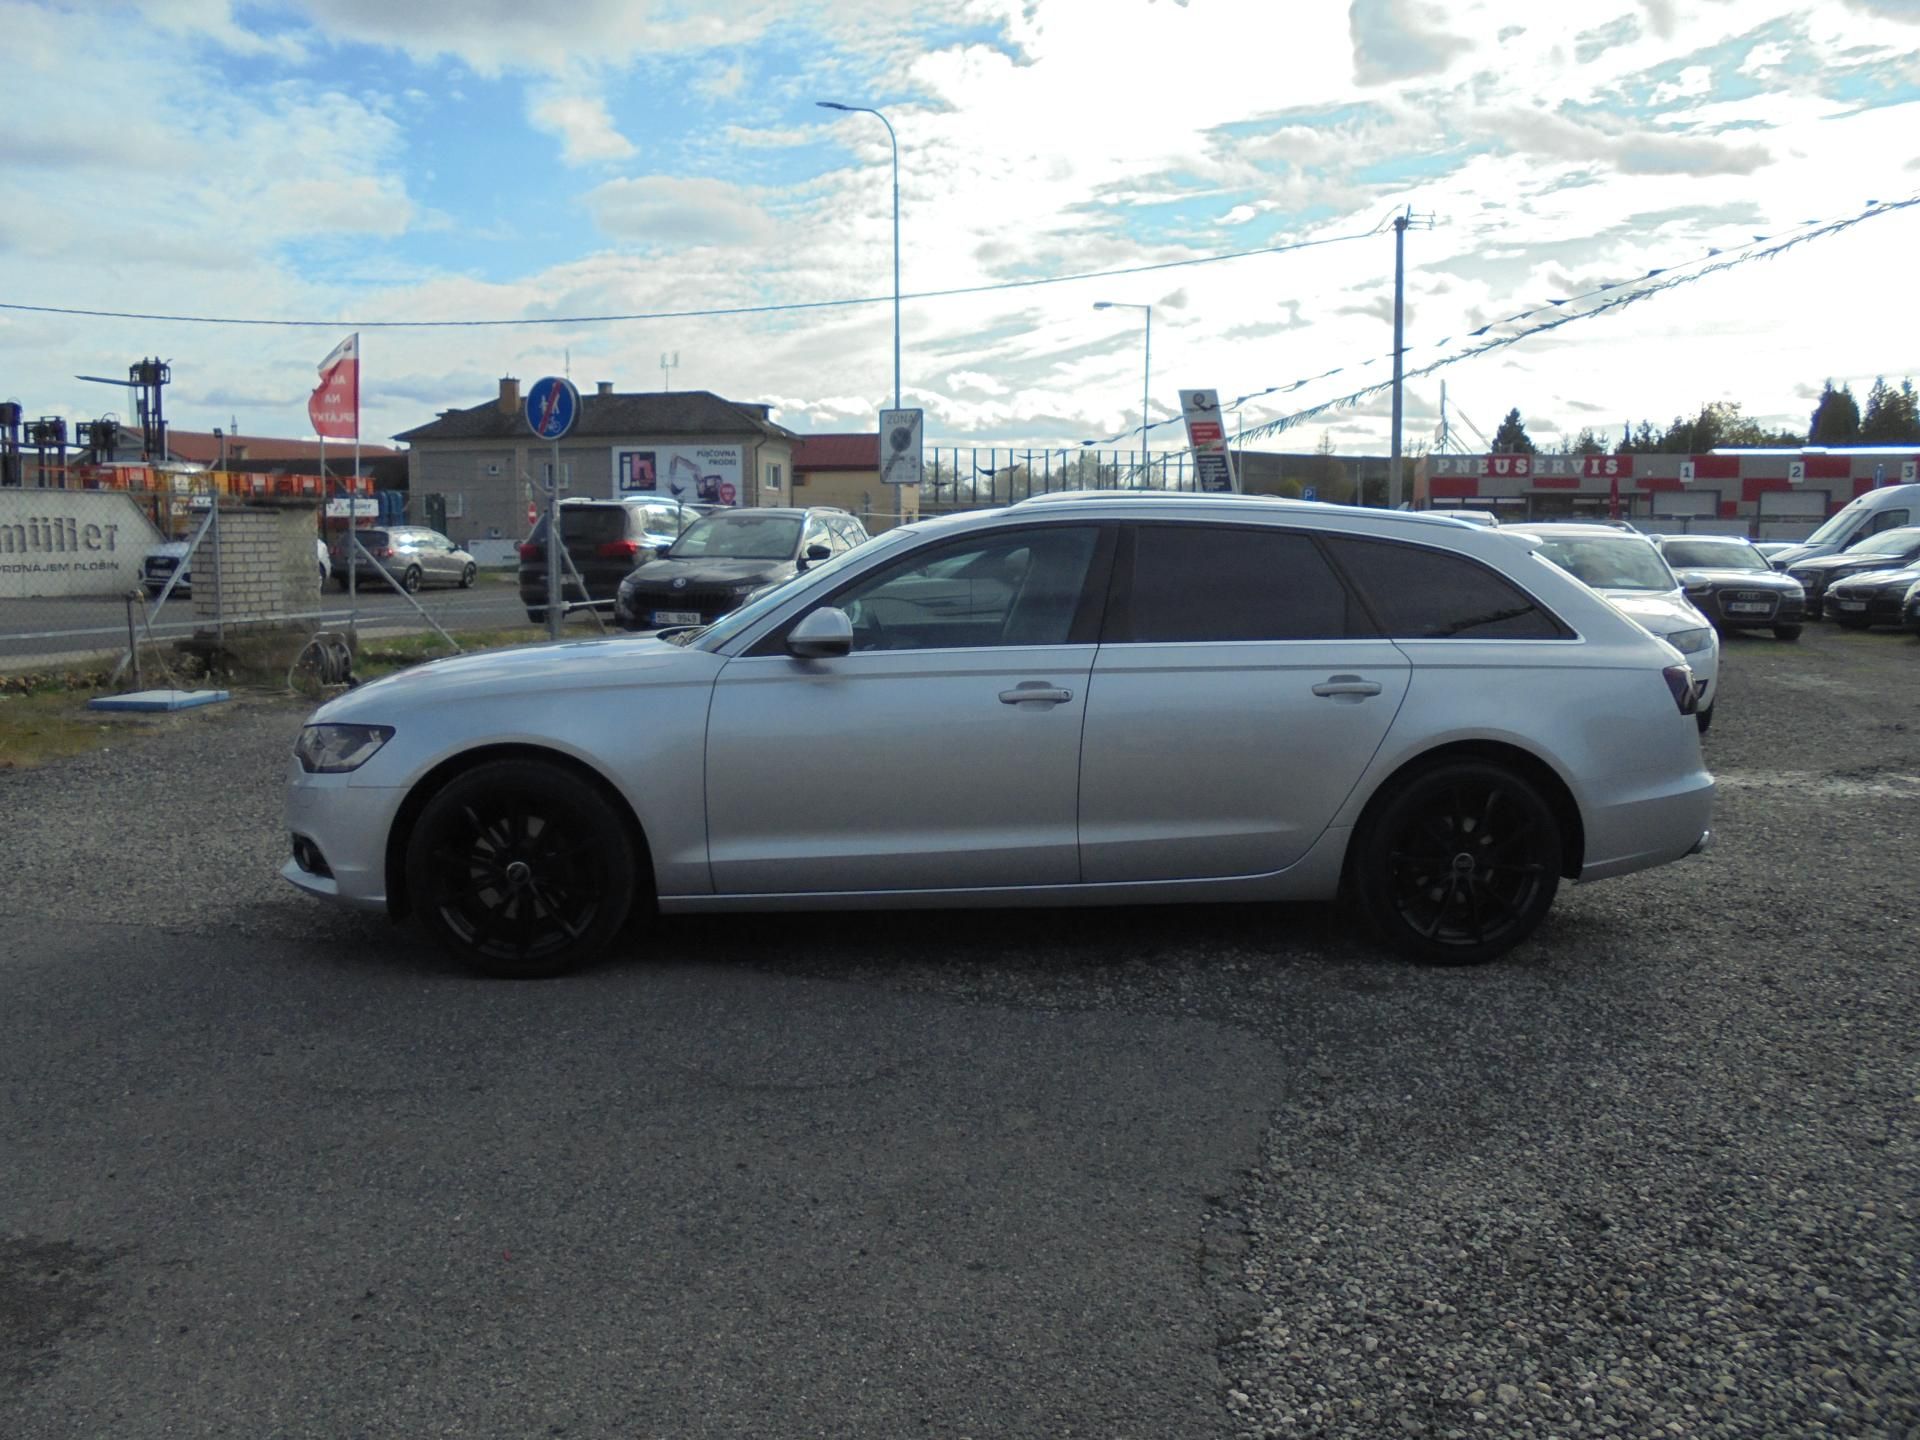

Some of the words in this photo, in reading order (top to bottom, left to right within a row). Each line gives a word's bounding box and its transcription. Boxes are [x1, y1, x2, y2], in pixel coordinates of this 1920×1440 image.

[1438, 459, 1618, 474] PNEUSERVIS
[1683, 467, 1691, 478] 1
[1791, 467, 1801, 478] 2
[1904, 467, 1913, 478] 3
[1305, 489, 1313, 499] P
